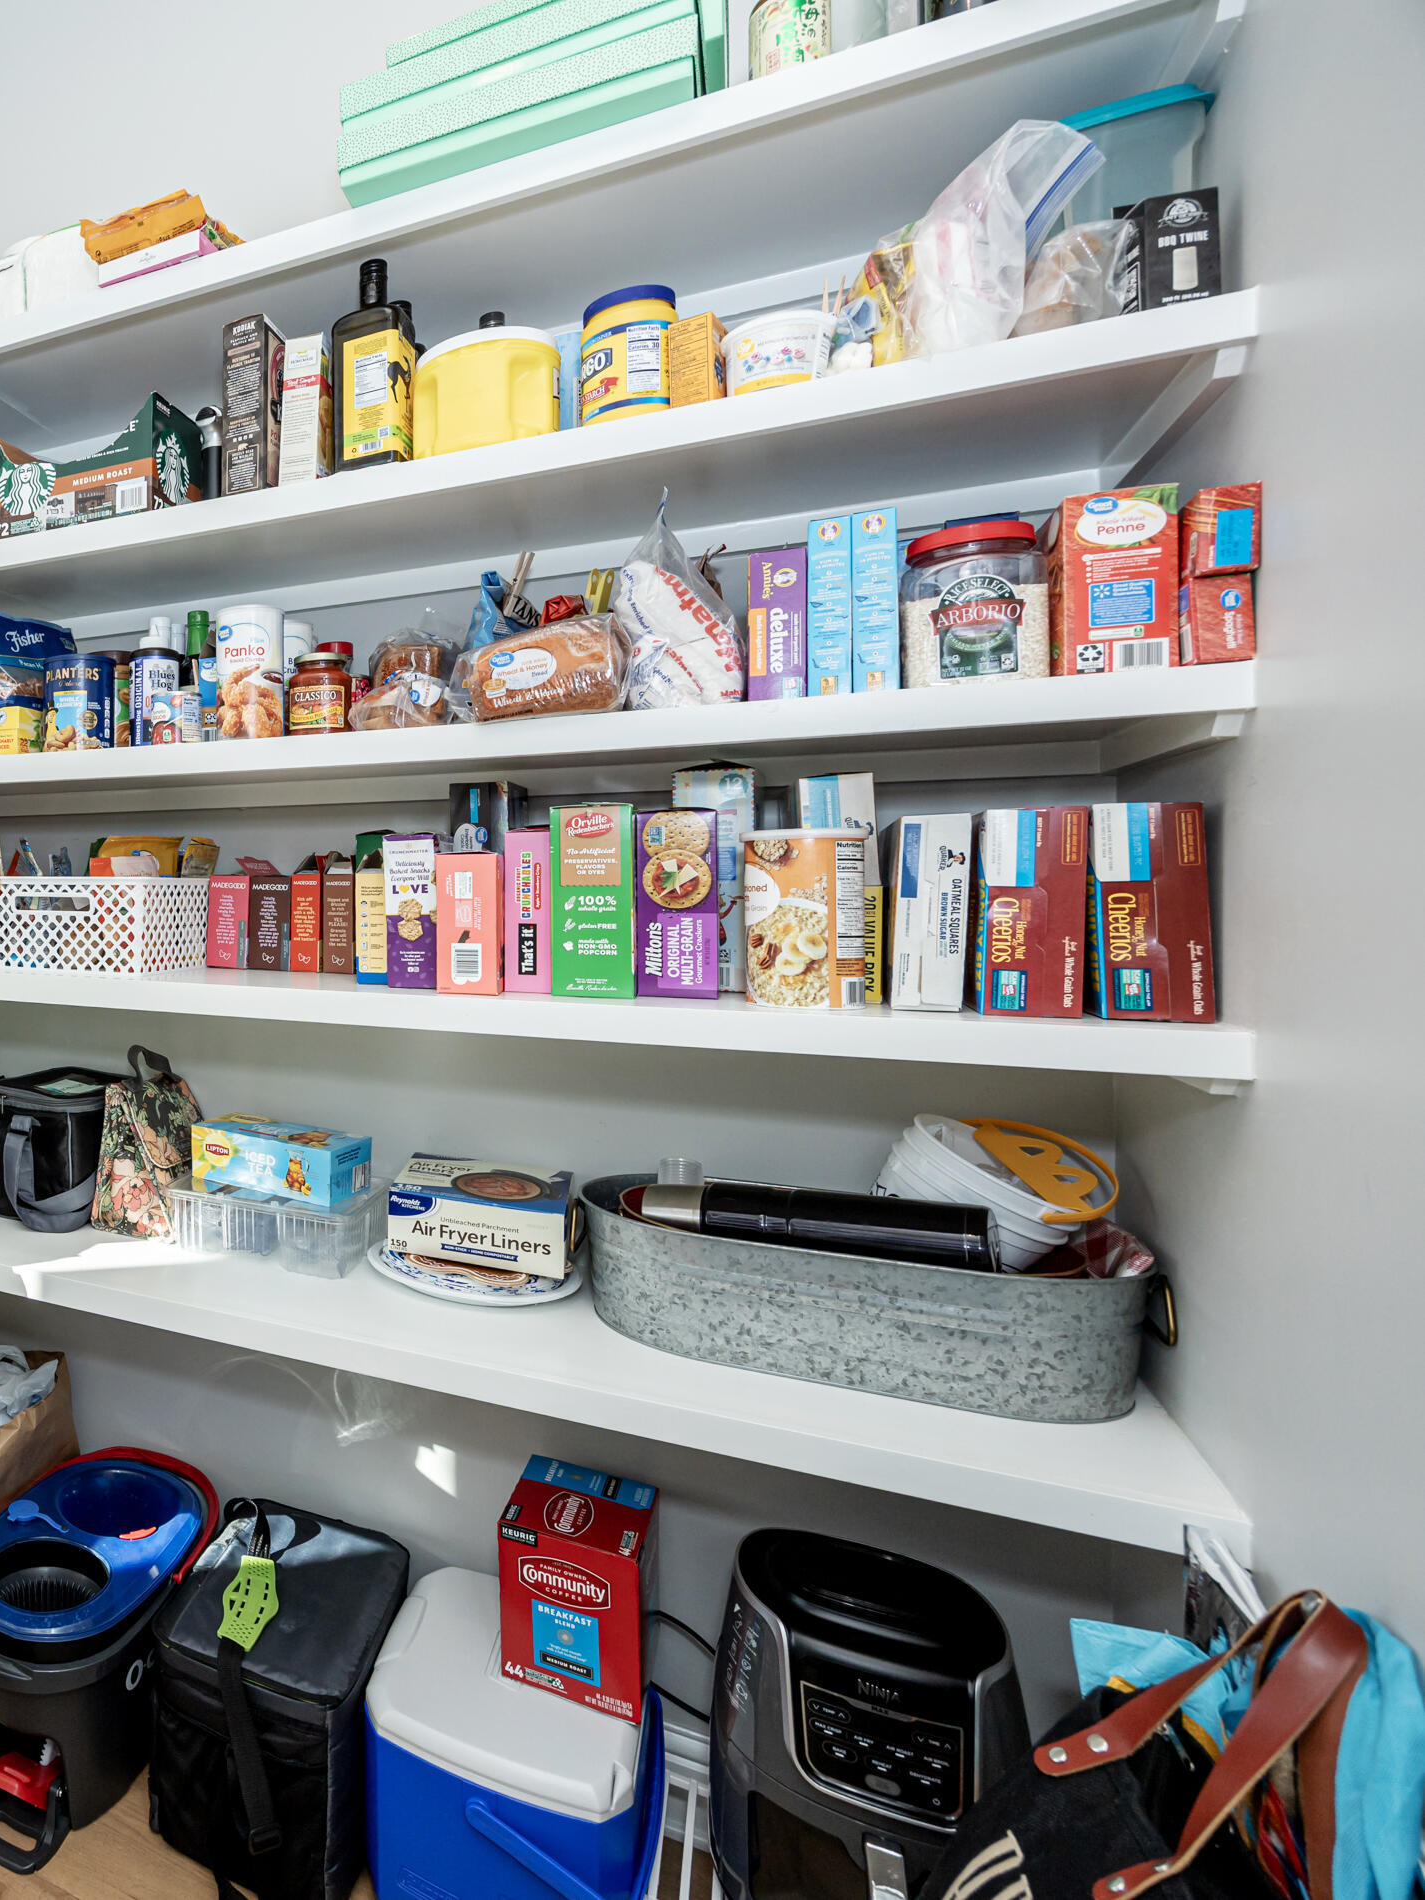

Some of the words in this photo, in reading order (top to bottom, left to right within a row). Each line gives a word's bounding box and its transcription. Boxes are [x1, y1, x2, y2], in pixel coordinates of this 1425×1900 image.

[1179, 229, 1209, 244] TWINE
[581, 350, 606, 380] RGO
[72, 473, 105, 487] MEDIUM
[106, 467, 133, 480] ROAST
[1097, 523, 1146, 536] Penne
[761, 560, 774, 601] Annie's
[944, 583, 968, 602] RICE
[970, 577, 1010, 596] SELECT
[935, 603, 1021, 628] ARBORIO
[4, 628, 45, 653] Fisher
[769, 607, 789, 674] deluxe
[224, 644, 265, 659] Panko
[45, 667, 100, 683] PLANTERS
[149, 670, 176, 680] Blues
[151, 679, 173, 692] Hog
[294, 690, 337, 702] CLASSICO
[724, 777, 743, 789] 12
[565, 821, 616, 837] Redenbacher's
[571, 814, 608, 829] Orville
[836, 841, 862, 849] Nutrition
[395, 860, 425, 868] Deliciously
[937, 845, 948, 872] QUAKER
[390, 875, 416, 883] Everyone
[417, 873, 430, 881] Will
[409, 866, 431, 874] Snacks
[211, 881, 247, 890] MADEGOOD
[252, 883, 289, 891] MADEGOOD
[521, 851, 532, 919] CRUNCHABLES
[577, 895, 617, 906] 100%
[939, 892, 949, 917] BROWN
[949, 878, 962, 916] OATMEAL
[694, 919, 703, 951] Crackers
[938, 918, 948, 940] SUGAR
[948, 917, 961, 955] SQUARES
[991, 897, 1020, 963] Cheerios
[1014, 920, 1027, 943] Honey
[1106, 892, 1138, 962] Cheerios
[1133, 916, 1147, 940] Honey
[521, 940, 534, 973] That's
[644, 921, 664, 978] Milton's
[667, 924, 680, 979] ORIGINAL
[681, 917, 694, 986] MULTI-GRAIN
[1014, 945, 1027, 960] Nut
[1135, 941, 1147, 957] Nut
[694, 951, 703, 984] Gourmet
[1063, 957, 1075, 976] Whole
[1191, 961, 1203, 981] Whole
[1063, 976, 1075, 993] Grain
[1192, 982, 1204, 1000] Grain
[1063, 993, 1075, 1008] Oats
[1193, 1000, 1205, 1015] Oats
[205, 1143, 230, 1156] LIPTON
[245, 1150, 276, 1167] ICED
[248, 1161, 274, 1178] TEA
[390, 1194, 421, 1207] Reynolds
[440, 1216, 481, 1228] Unbleached
[481, 1222, 520, 1234] Parchment
[390, 1238, 408, 1248] 150
[411, 1219, 436, 1238] Air
[439, 1224, 489, 1246] Fryer
[491, 1232, 552, 1256] Liners
[554, 1494, 585, 1533] Community
[501, 1526, 537, 1543] KEURIG
[539, 1563, 562, 1574] FAMILY
[563, 1571, 587, 1581] OWNED
[522, 1563, 606, 1604] Community
[545, 1586, 583, 1603] COFFEE
[537, 1604, 592, 1627] BREAKFAST
[554, 1618, 576, 1630] BLEND
[504, 1661, 524, 1679] 44
[546, 1656, 569, 1668] MEDIUM
[569, 1664, 587, 1675] ROAST
